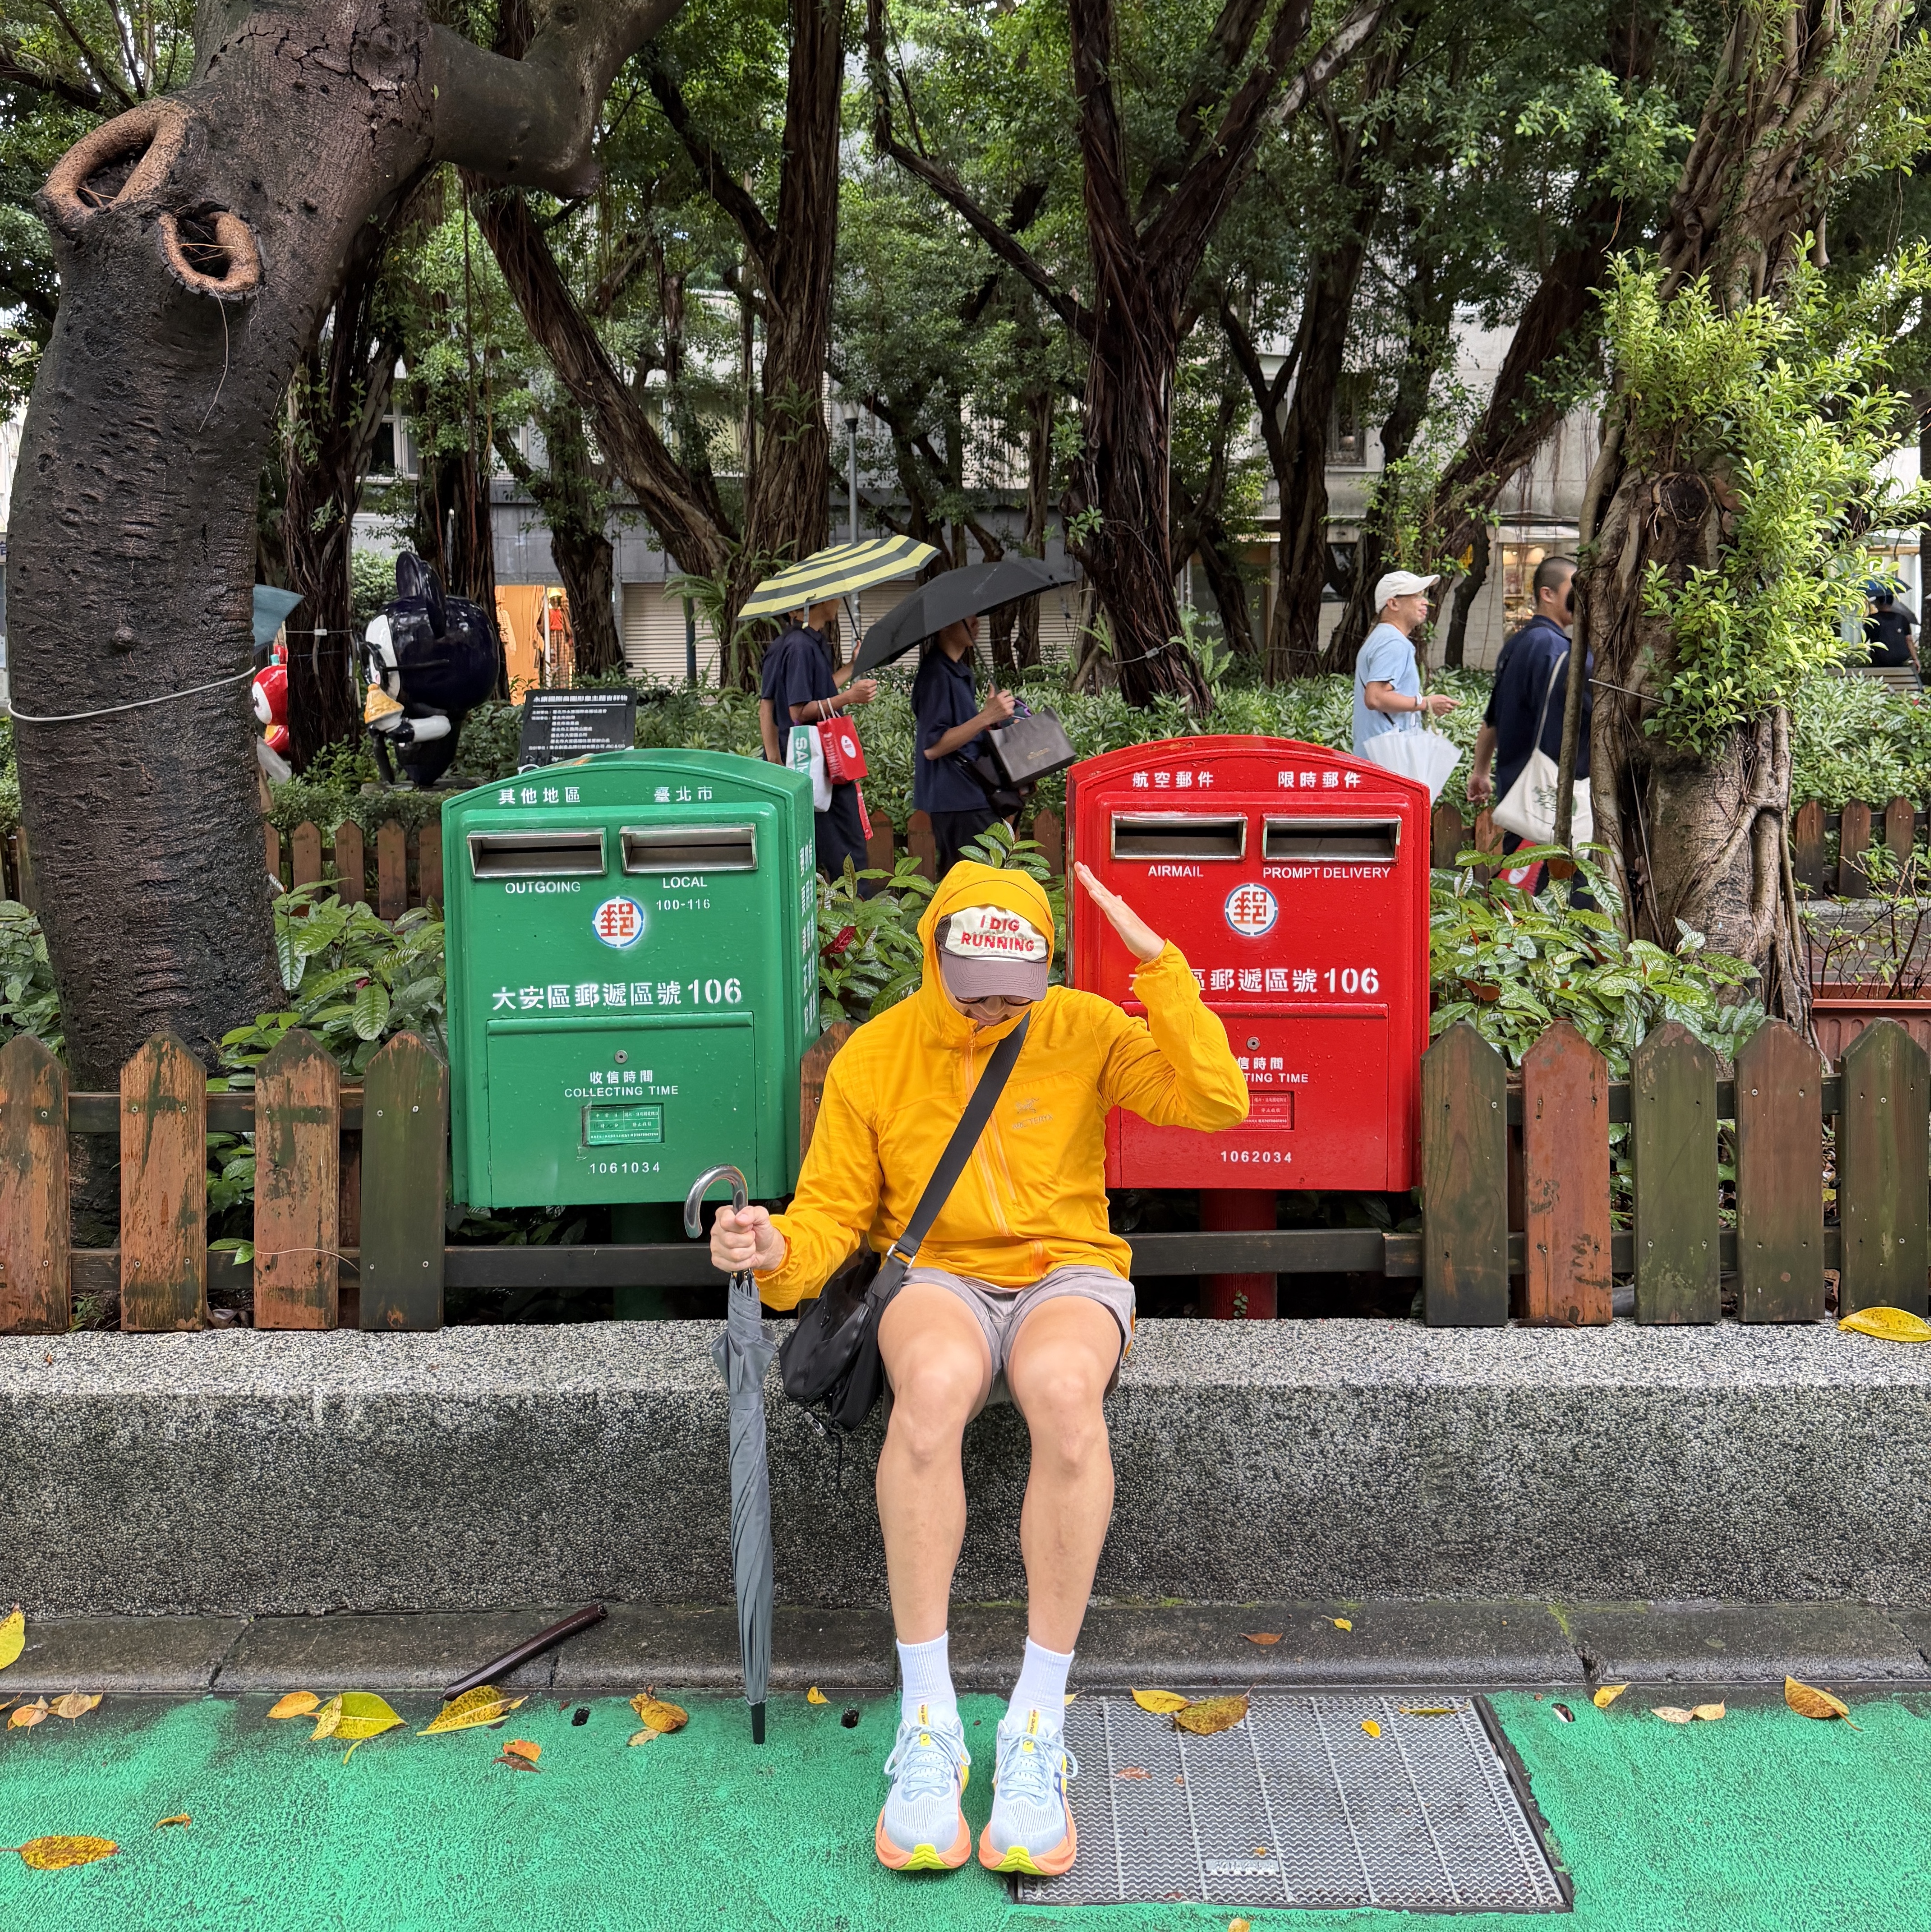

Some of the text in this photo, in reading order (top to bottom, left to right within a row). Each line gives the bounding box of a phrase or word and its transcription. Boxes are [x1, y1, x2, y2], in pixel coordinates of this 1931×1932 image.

[1133, 771, 1214, 788] 航空郵件
[1278, 771, 1361, 788] 限時郵件
[498, 787, 581, 805] 其他地區
[654, 786, 713, 802] 臺北市
[1148, 865, 1203, 877] AIRMAIL
[1263, 867, 1390, 878] PROMPT DELIVERY
[505, 881, 581, 894] OUTGOING
[663, 877, 707, 888] LOCAL
[656, 899, 711, 910] 100-116
[980, 915, 1020, 932] I DIG
[961, 932, 1034, 951] RUNNING
[590, 1070, 653, 1084] 收信時間
[1278, 1073, 1308, 1083] TIME
[564, 1085, 679, 1097] COLLECTING TIME
[1221, 1151, 1292, 1163] 1062034
[590, 1162, 660, 1174] 1061034
